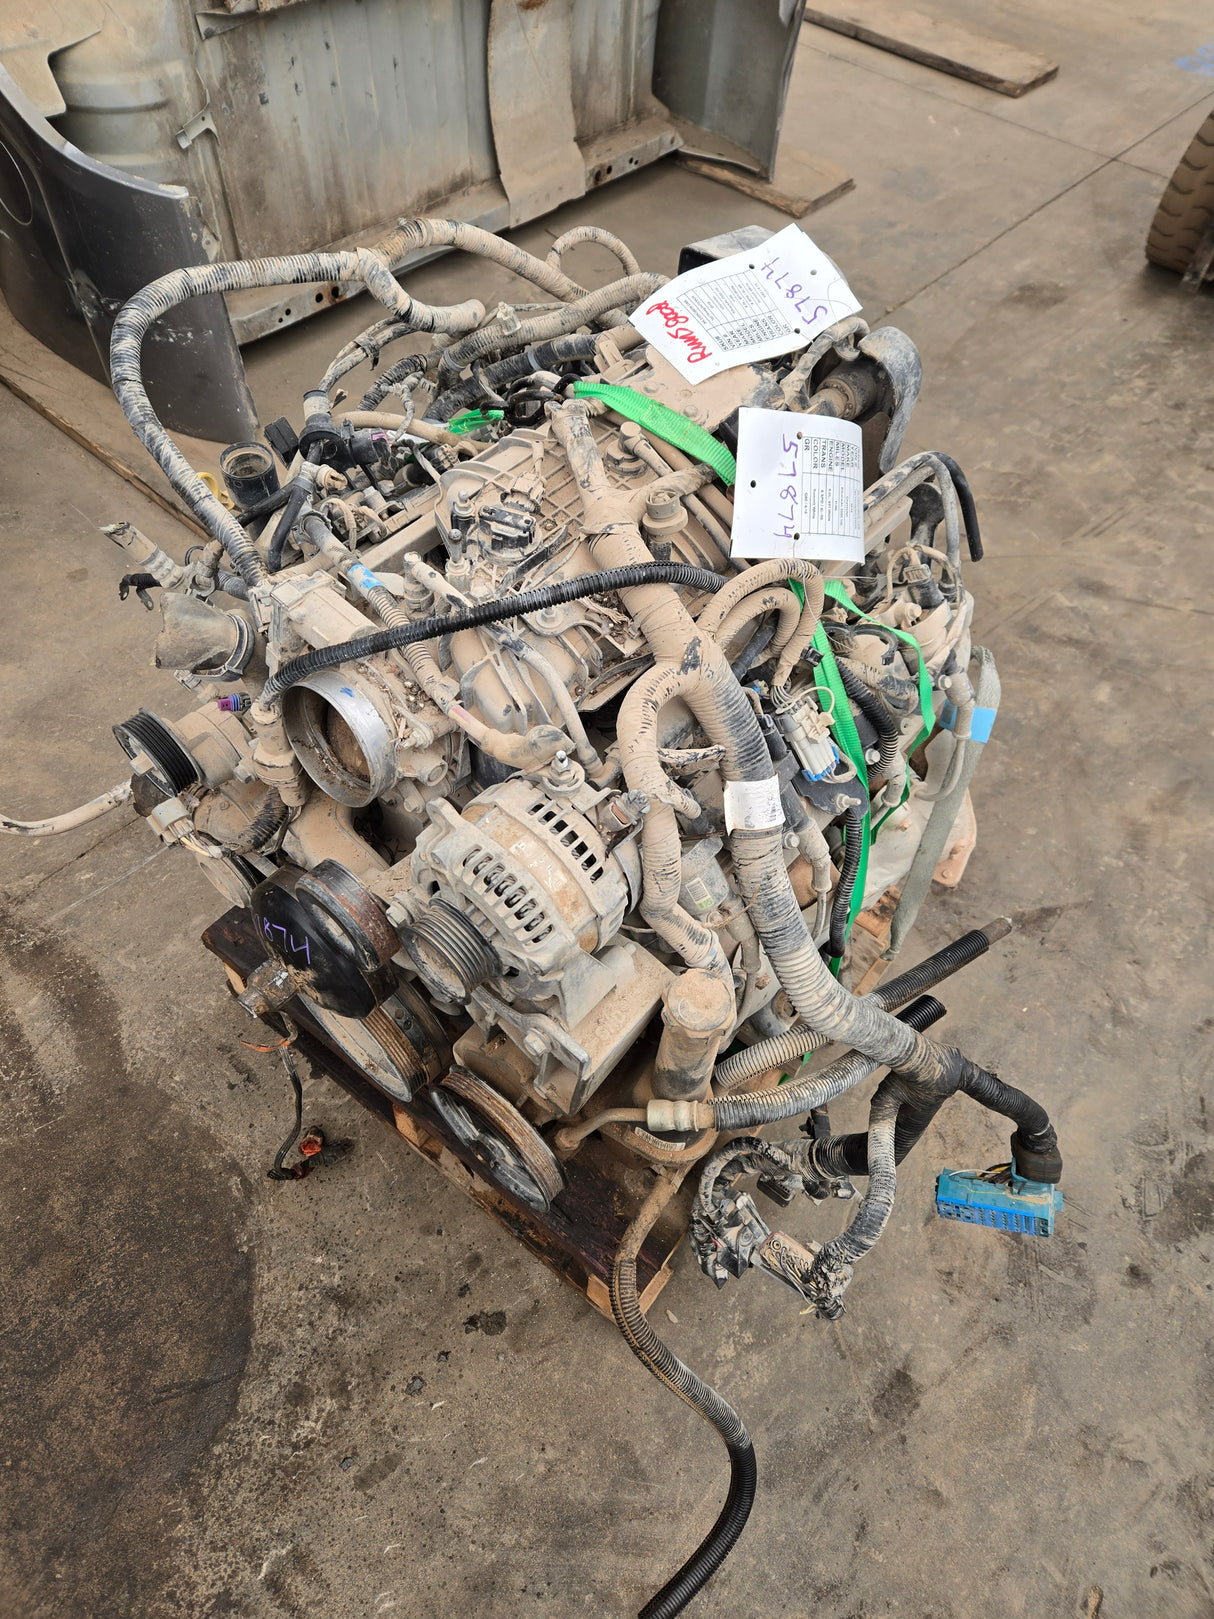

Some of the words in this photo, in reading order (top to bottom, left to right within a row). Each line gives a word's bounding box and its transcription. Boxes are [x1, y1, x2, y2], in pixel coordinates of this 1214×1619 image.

[761, 257, 828, 325] 57874
[741, 322, 755, 343] MODEL
[749, 324, 762, 341] MILES
[753, 318, 769, 339] ENGINE
[761, 318, 776, 337] TRANS
[767, 315, 783, 335] COLOR
[729, 330, 742, 345] YEAR
[736, 328, 749, 344] MAKE
[773, 433, 798, 538] 57874
